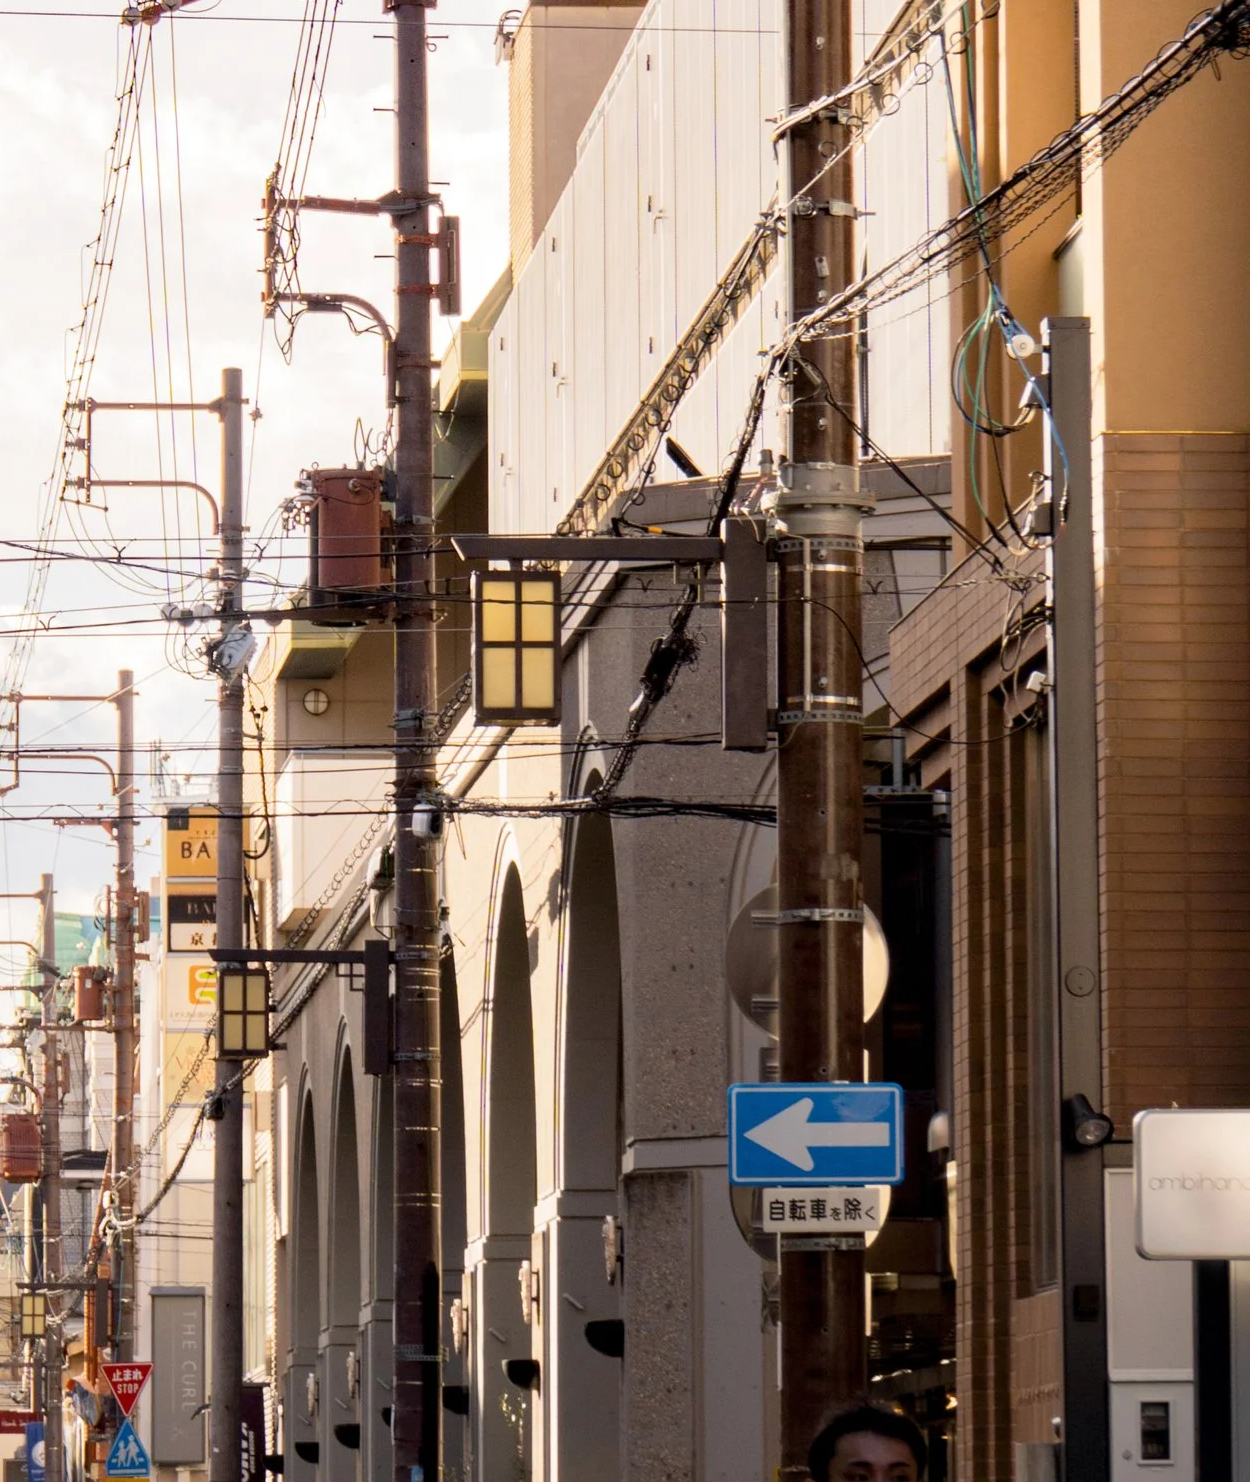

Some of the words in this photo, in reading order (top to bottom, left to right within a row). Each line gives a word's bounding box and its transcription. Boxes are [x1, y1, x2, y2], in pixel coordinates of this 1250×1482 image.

[769, 1197, 876, 1222] 自転車を除く
[182, 1310, 197, 1350] THE
[111, 1368, 144, 1382] 止まれ
[181, 1360, 197, 1410] CURL
[116, 1383, 140, 1394] STOP
